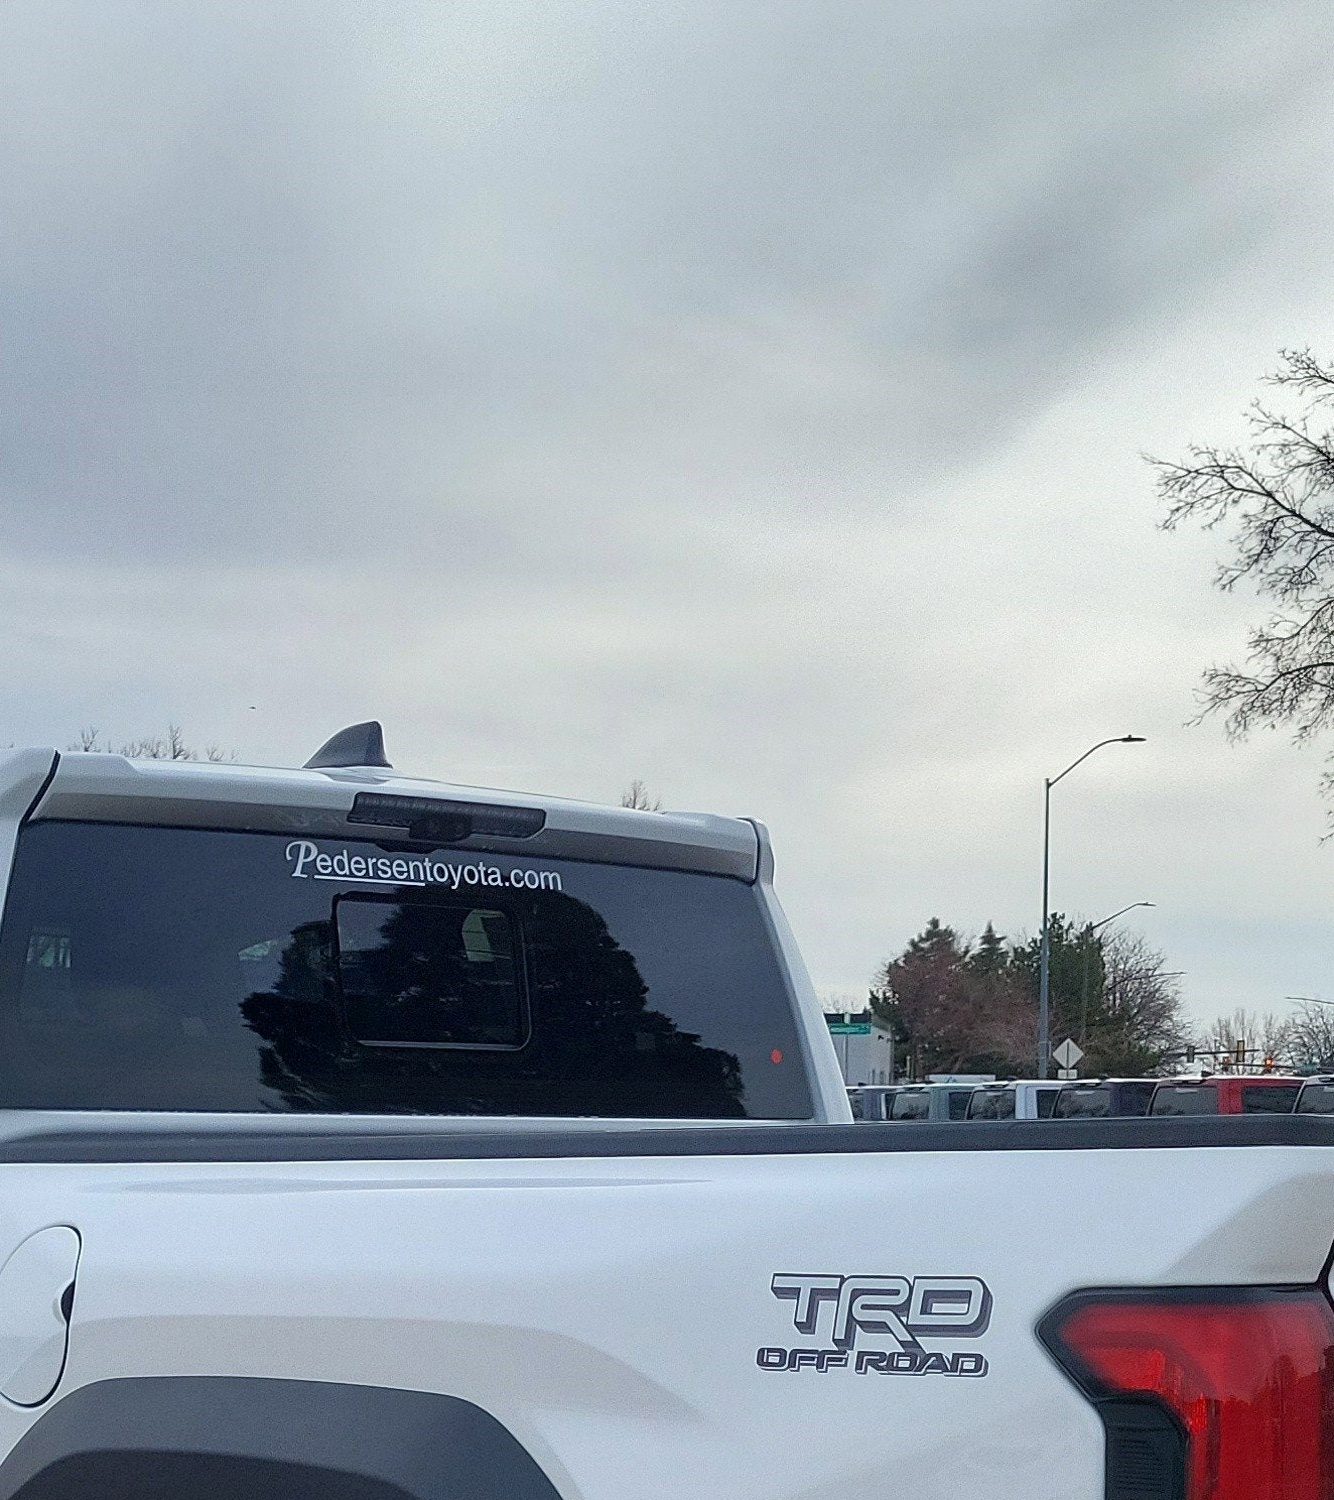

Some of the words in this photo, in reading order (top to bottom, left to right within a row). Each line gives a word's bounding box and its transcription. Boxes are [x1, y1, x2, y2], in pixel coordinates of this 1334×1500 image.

[286, 841, 563, 891] Pedersentoyota.com
[770, 1272, 994, 1354] TRD
[756, 1347, 849, 1373] OFF
[855, 1351, 990, 1378] ROAD
